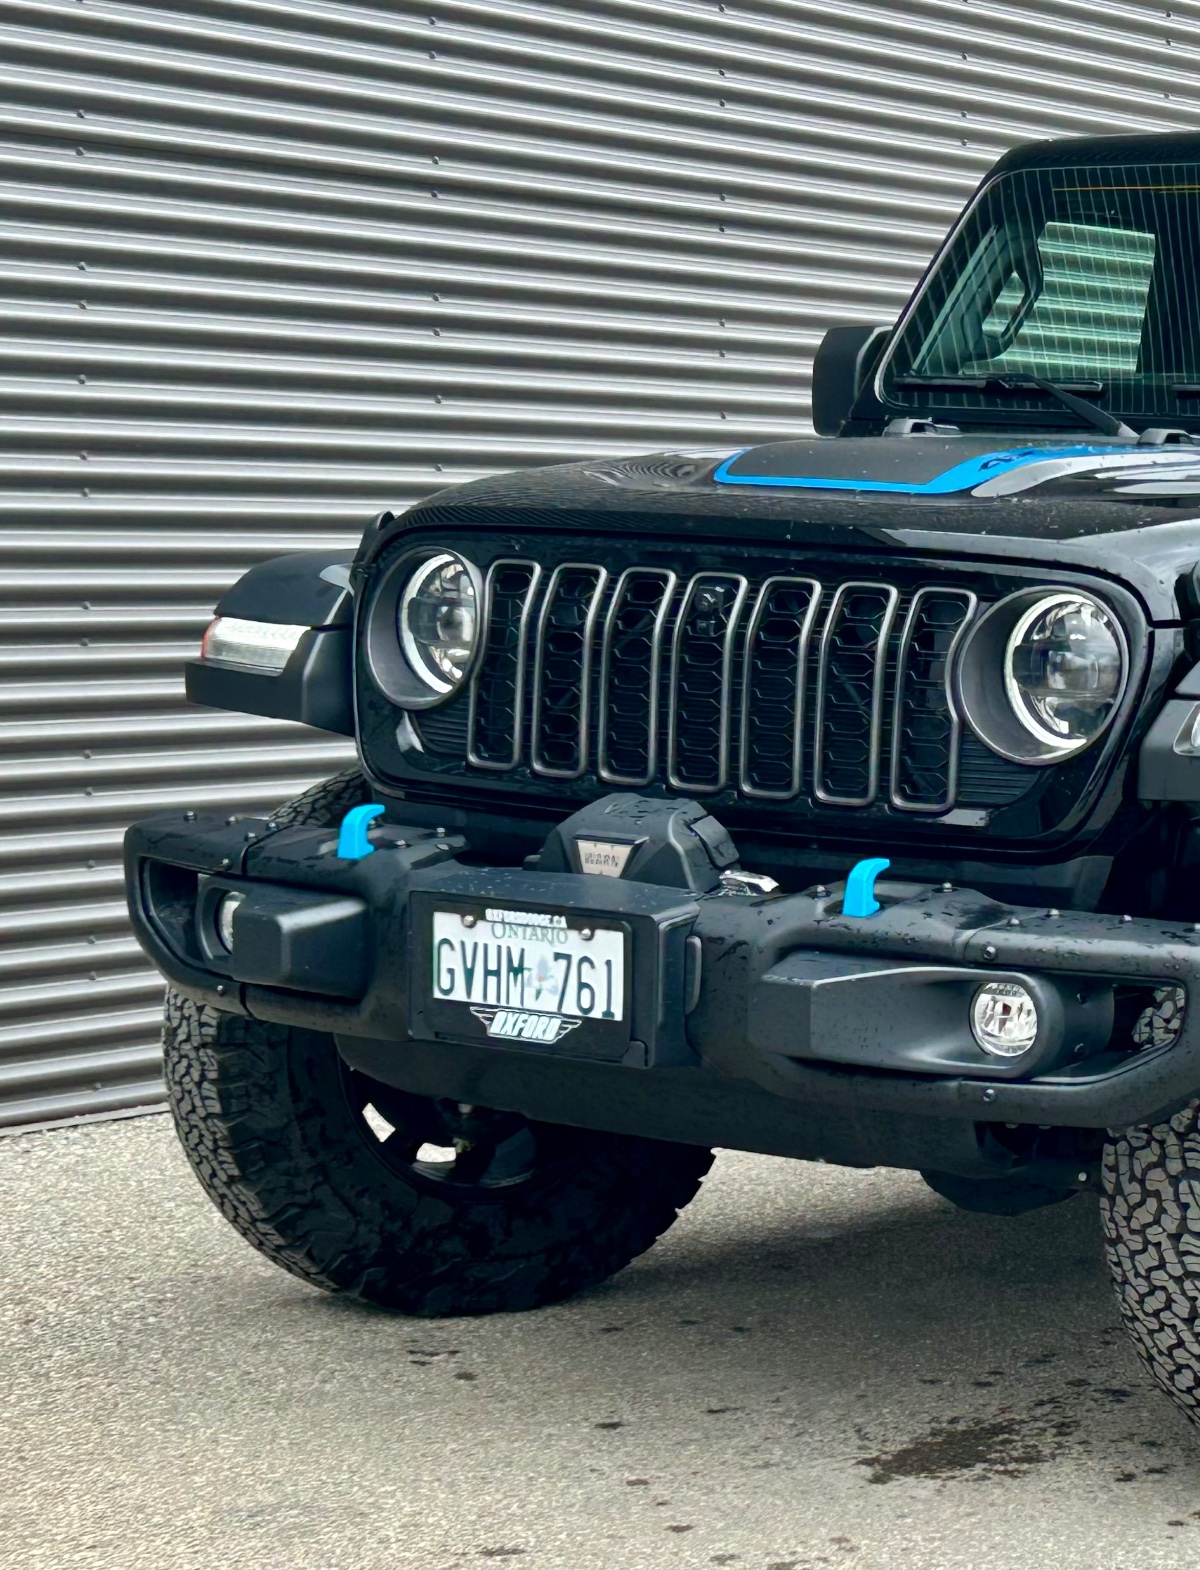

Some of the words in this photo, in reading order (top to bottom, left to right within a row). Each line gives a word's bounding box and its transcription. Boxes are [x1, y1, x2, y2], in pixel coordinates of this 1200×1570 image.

[437, 937, 526, 1008] GVHM
[553, 951, 616, 1020] 761
[489, 1010, 563, 1039] OXFORD
